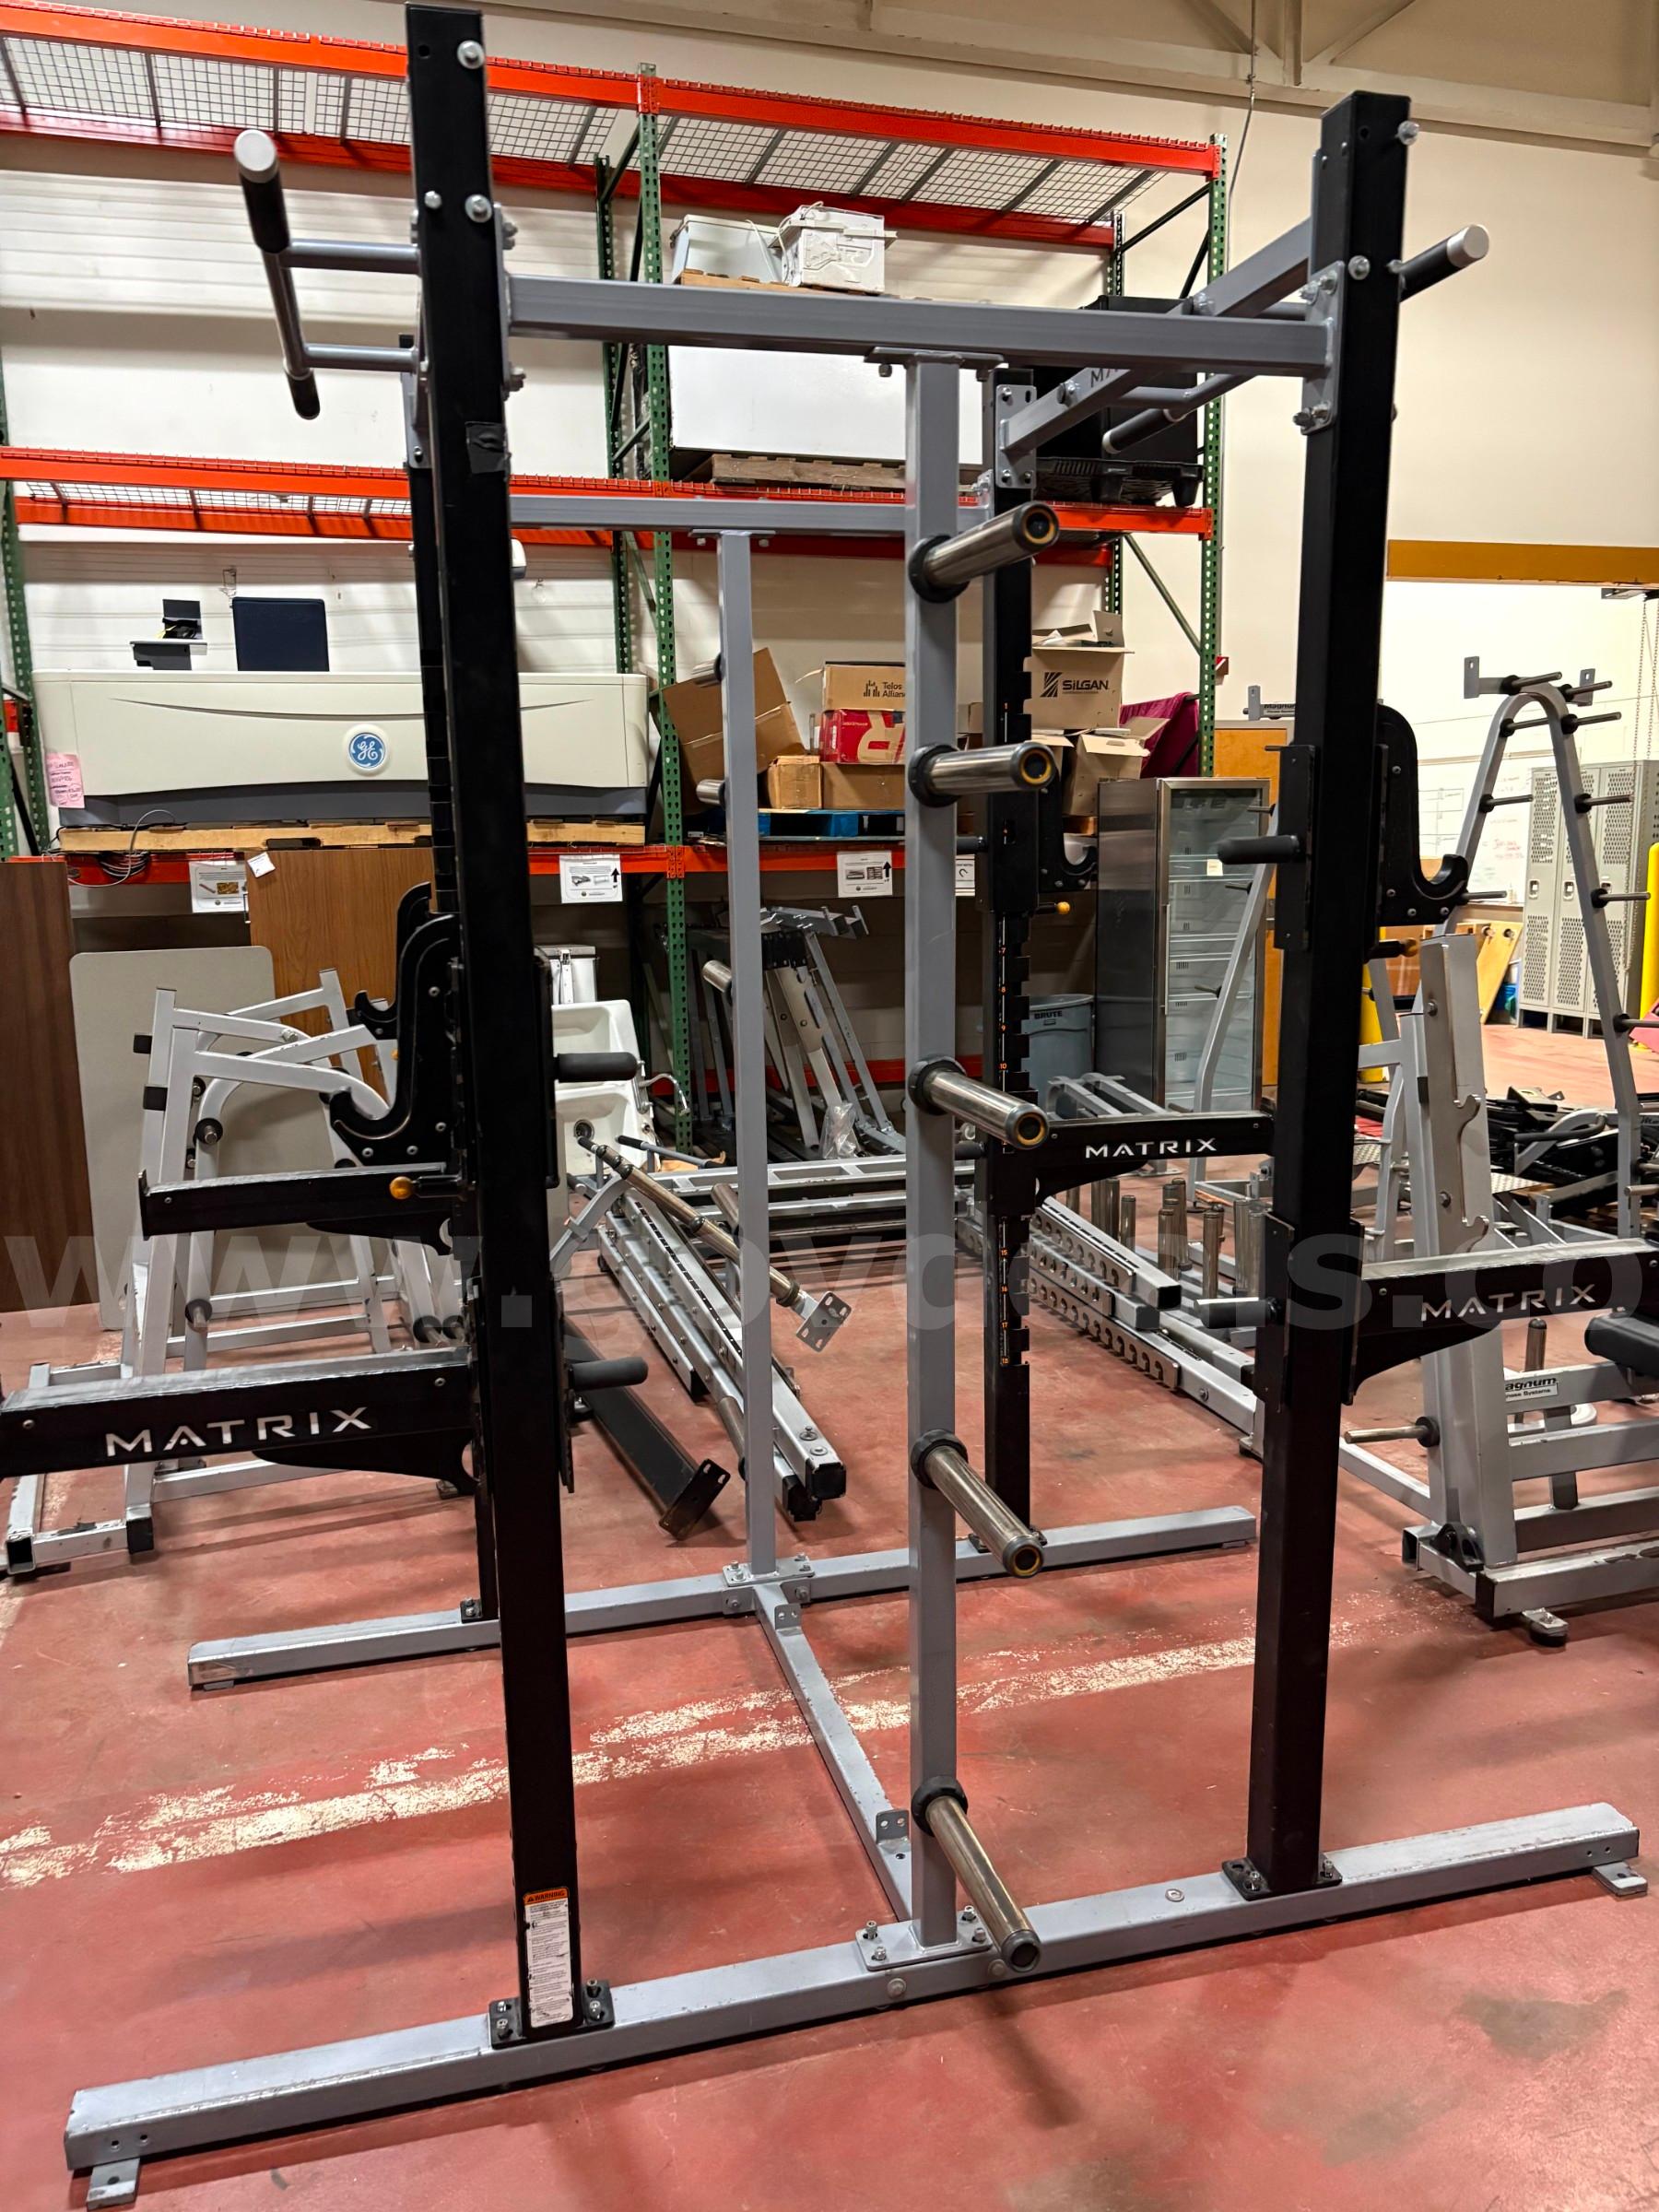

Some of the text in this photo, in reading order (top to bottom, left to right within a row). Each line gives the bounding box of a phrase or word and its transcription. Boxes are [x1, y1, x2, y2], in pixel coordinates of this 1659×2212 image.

[882, 681, 902, 690] Telos
[882, 689, 905, 698] Allian
[1085, 1137, 1218, 1159] MATRIX
[1420, 1283, 1596, 1322] MATRIX
[1505, 1377, 1558, 1392] agnum
[1523, 1388, 1552, 1397] Systems
[104, 1406, 372, 1457] MATRIX
[535, 1889, 566, 1901] WARNING
